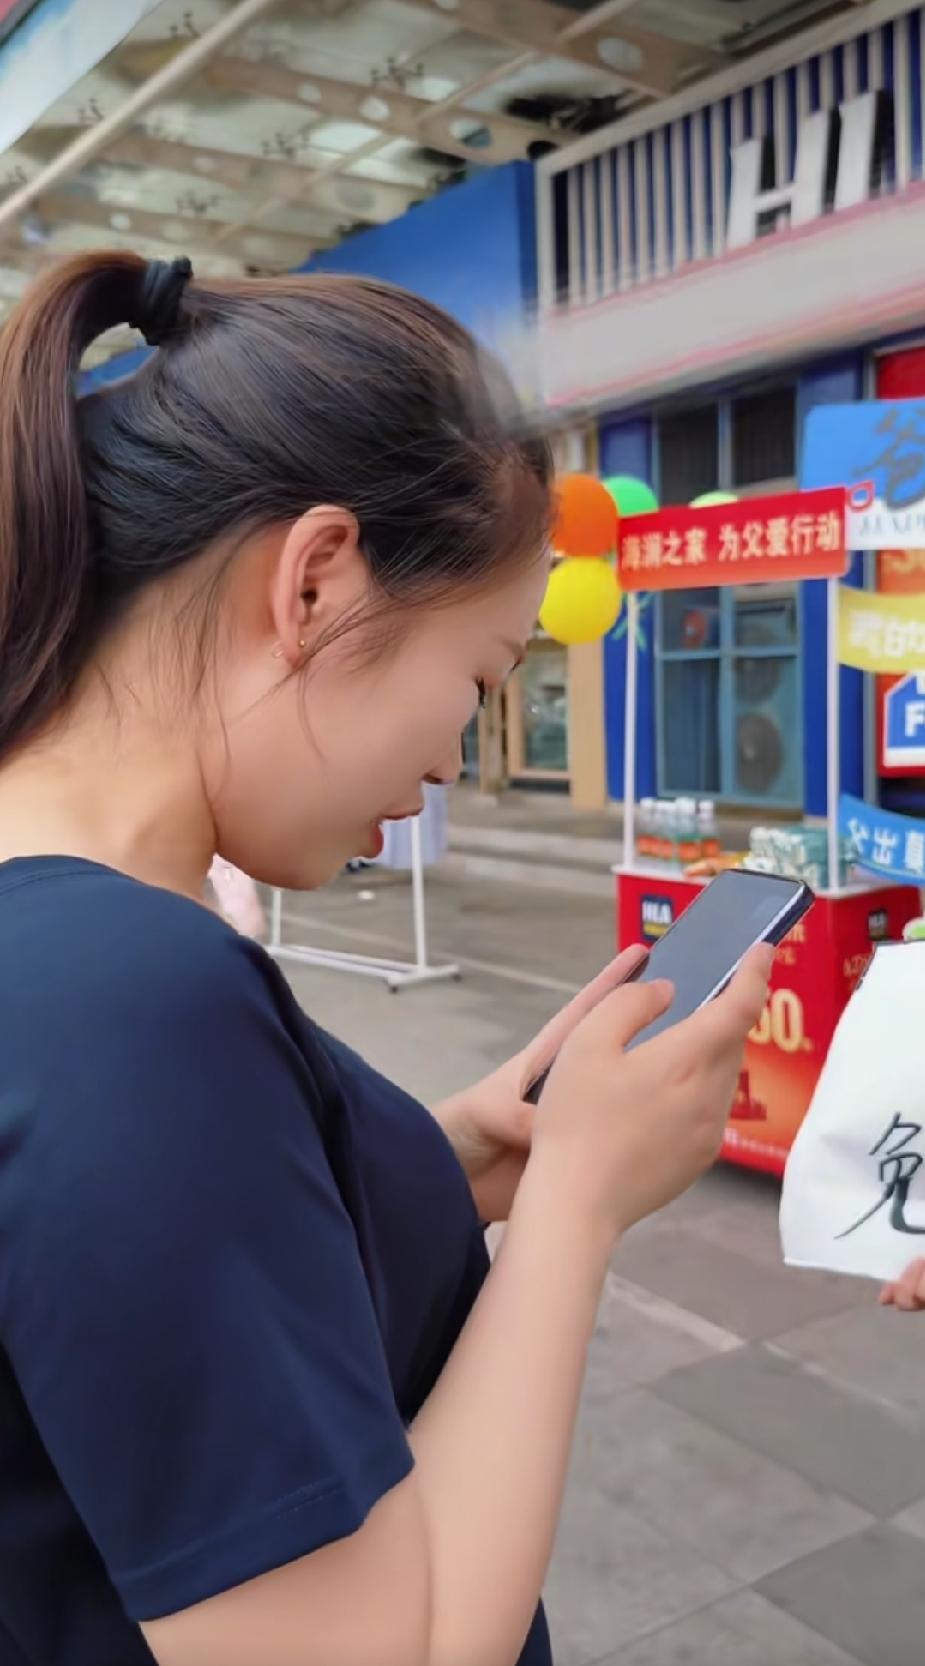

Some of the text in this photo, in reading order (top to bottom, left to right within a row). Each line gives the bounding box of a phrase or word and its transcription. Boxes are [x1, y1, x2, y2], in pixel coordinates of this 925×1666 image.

[621, 528, 707, 570] 海澜之家
[718, 510, 841, 561] 为父爱行动
[834, 1112, 925, 1240] 免
